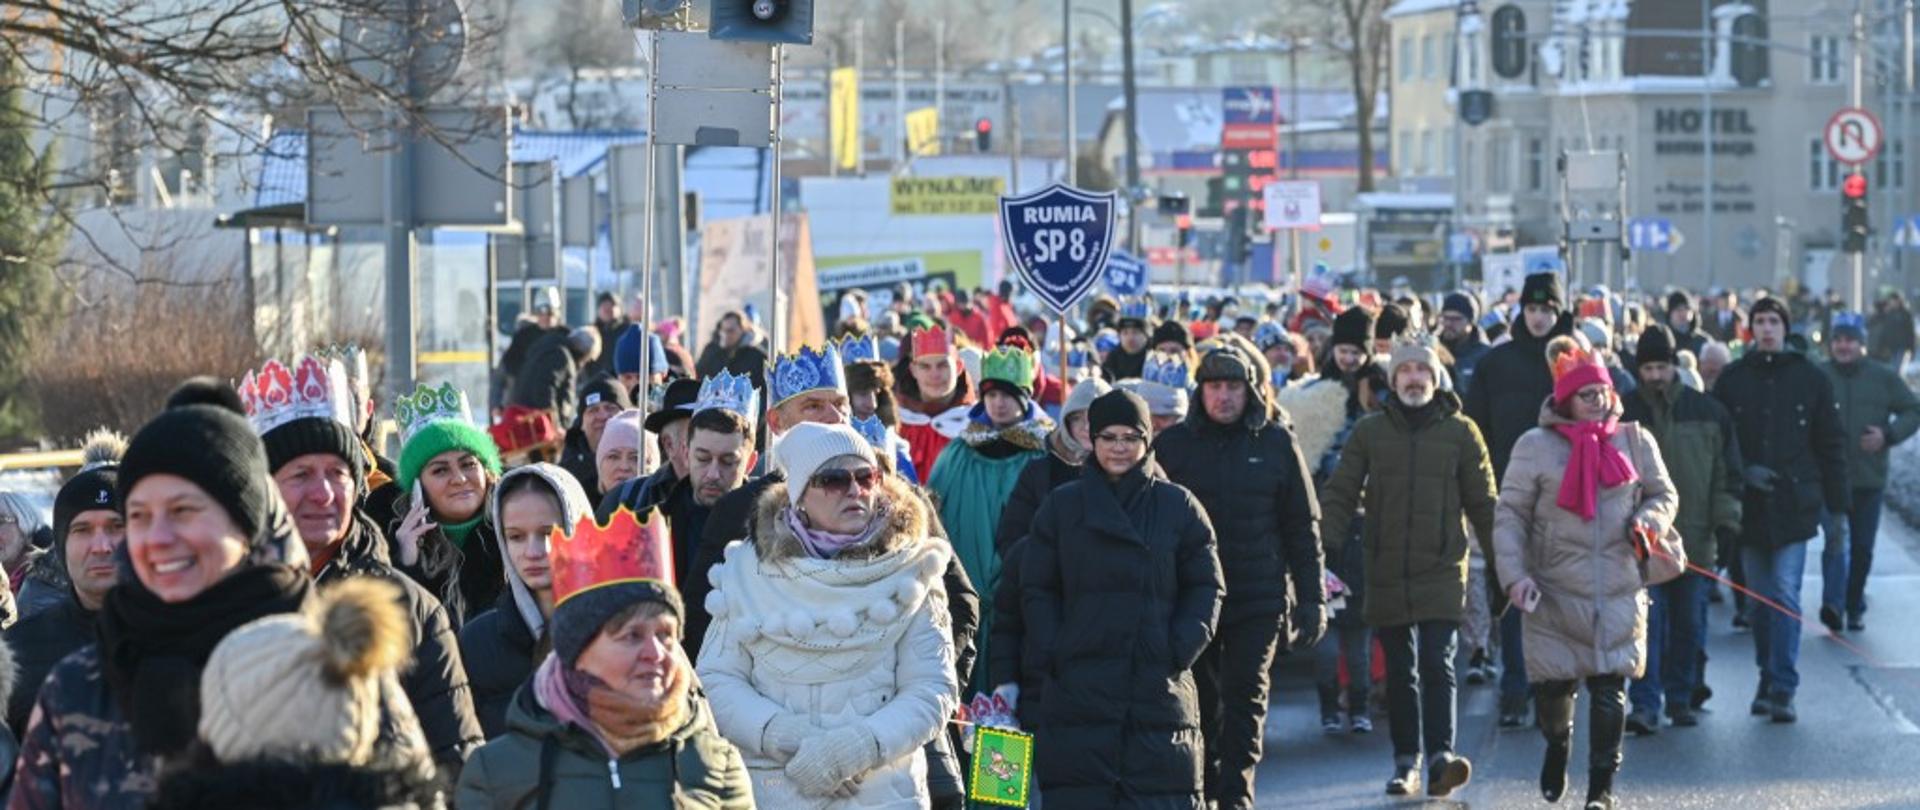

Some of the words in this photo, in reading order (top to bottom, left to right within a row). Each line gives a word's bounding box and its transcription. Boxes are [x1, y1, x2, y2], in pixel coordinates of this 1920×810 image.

[1655, 108, 1756, 133] HOTEL
[1024, 205, 1096, 224] RUMIA
[1034, 228, 1066, 263] SP
[1070, 227, 1086, 262] 8
